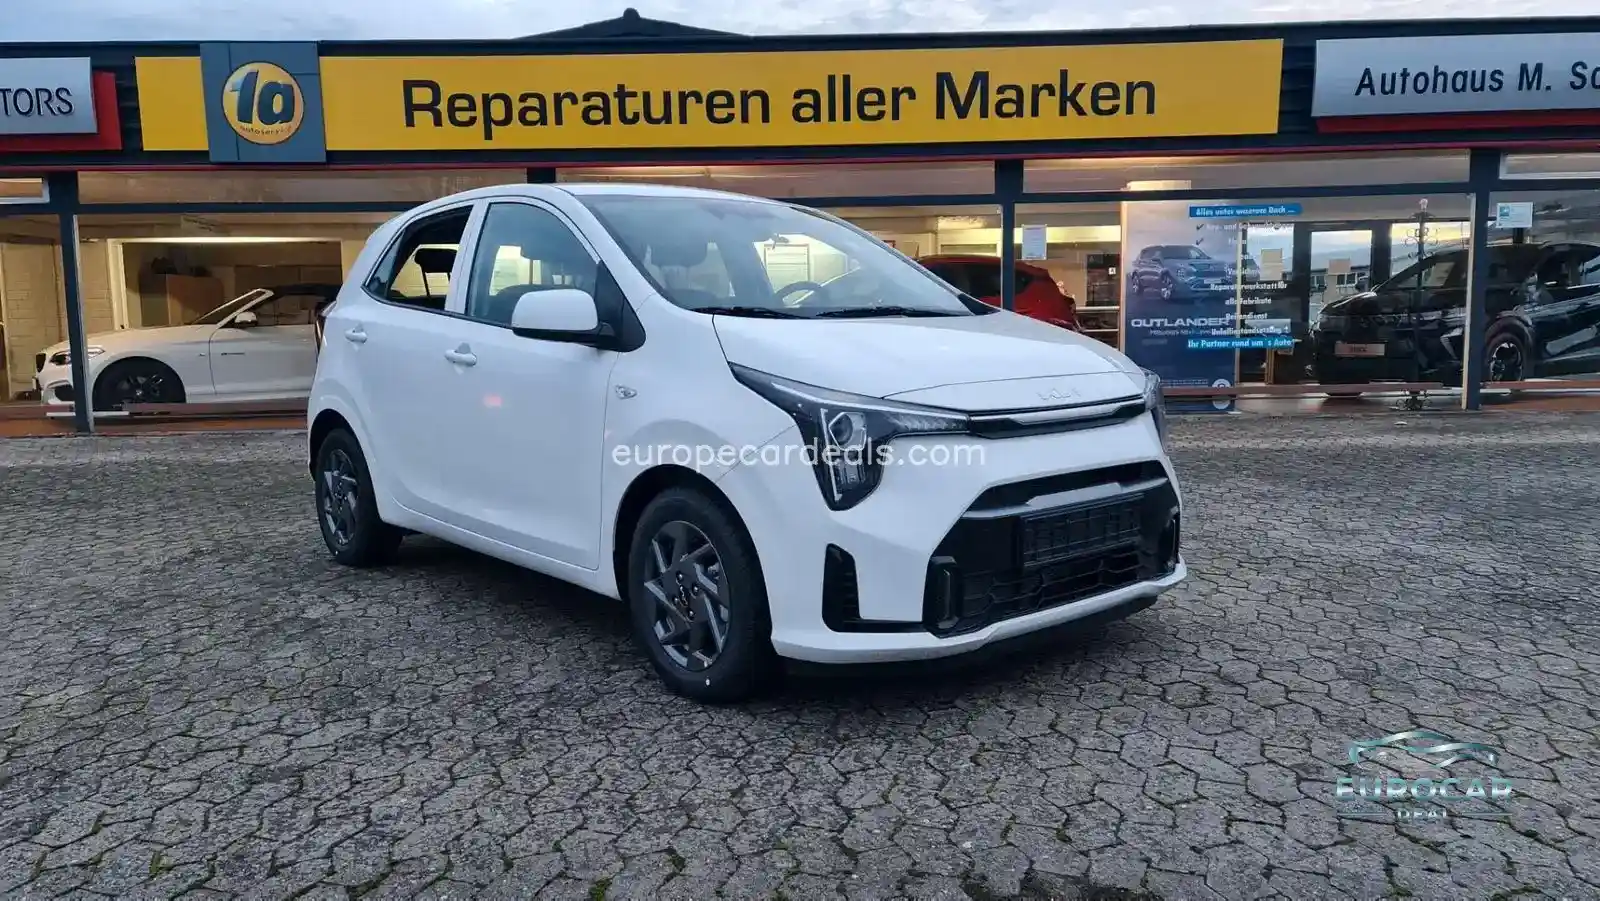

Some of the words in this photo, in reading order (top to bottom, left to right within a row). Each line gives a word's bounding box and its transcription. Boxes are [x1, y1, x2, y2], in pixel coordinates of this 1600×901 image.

[1354, 65, 1504, 96] Autohaus
[1517, 62, 1551, 92] M.
[0, 87, 74, 117] TORS
[229, 69, 295, 125] 1a
[402, 79, 770, 141] Reparaturen
[791, 74, 916, 123] aller
[935, 69, 1155, 120] Marken
[1268, 205, 1286, 214] Dach
[1131, 317, 1229, 328] OUTLANDER
[1188, 339, 1200, 348] Ihr
[1201, 339, 1230, 348] Partner
[1231, 337, 1250, 347] rund
